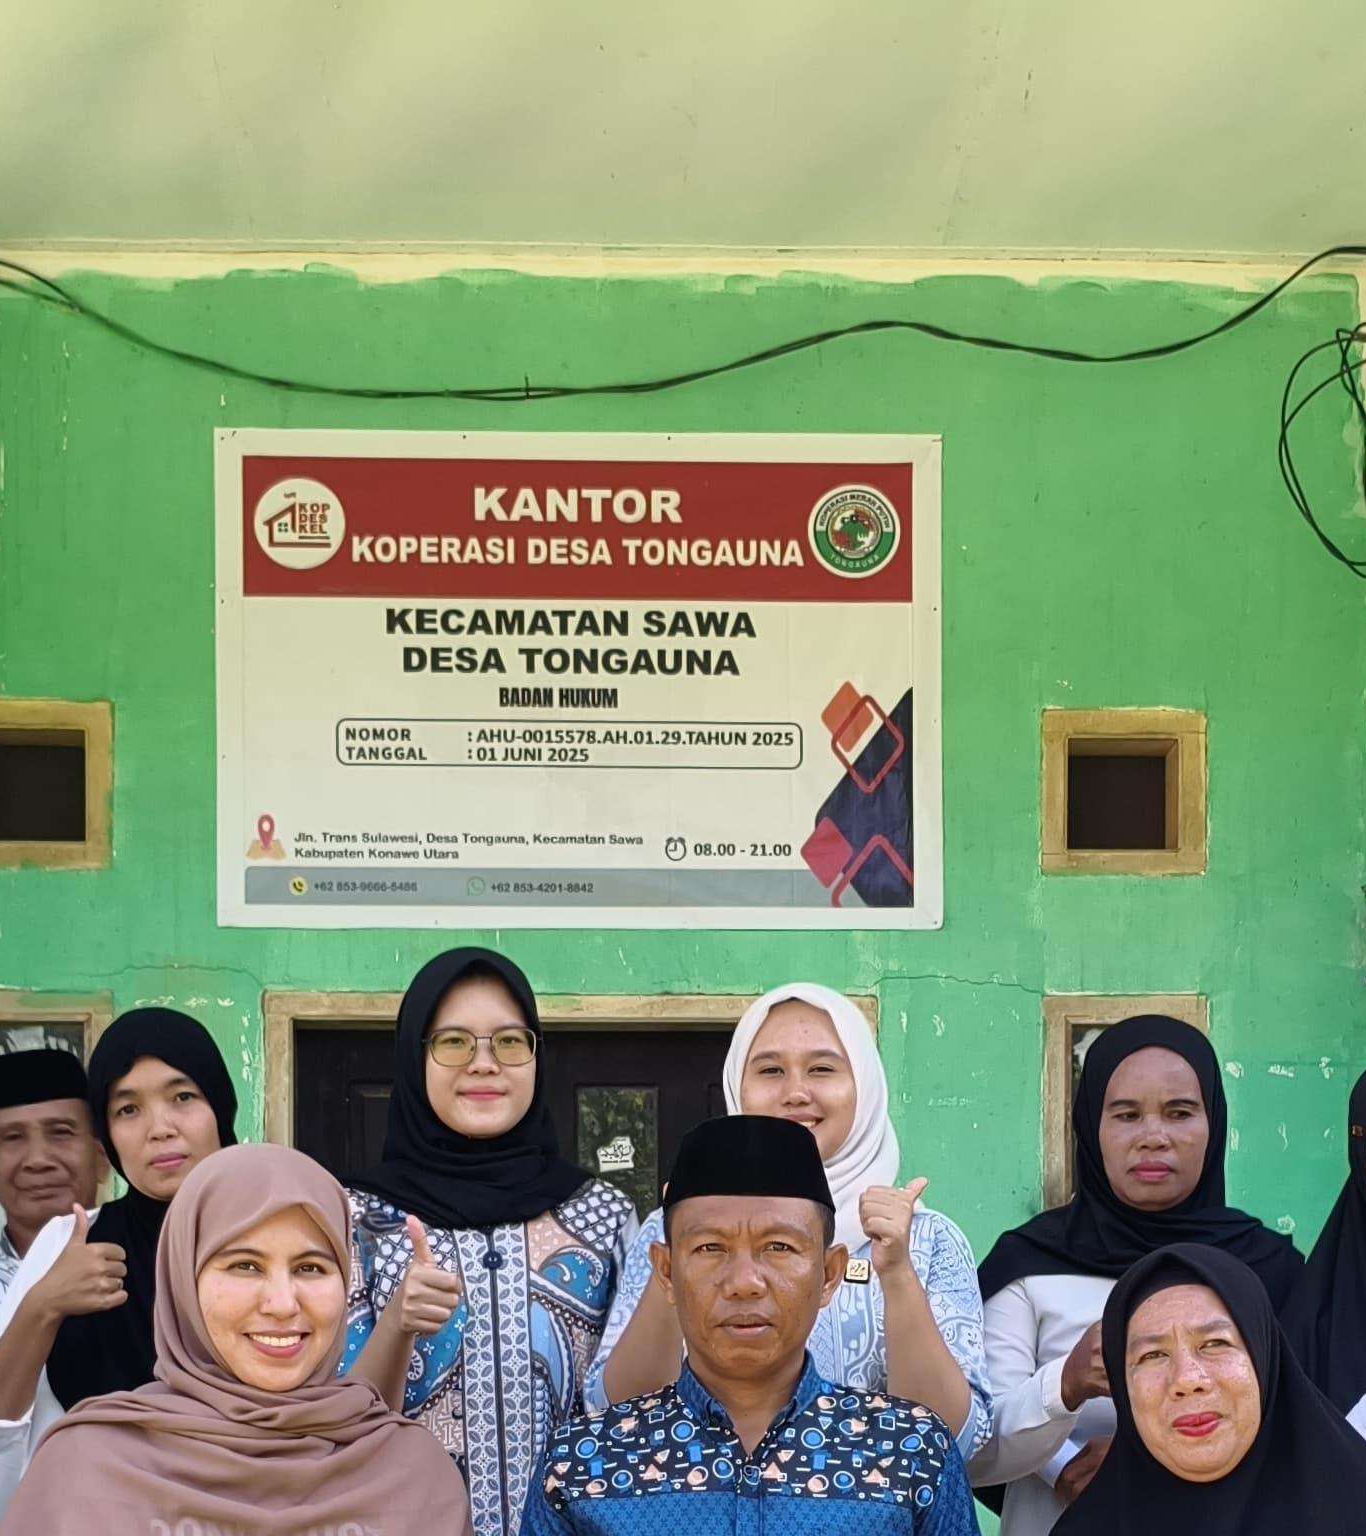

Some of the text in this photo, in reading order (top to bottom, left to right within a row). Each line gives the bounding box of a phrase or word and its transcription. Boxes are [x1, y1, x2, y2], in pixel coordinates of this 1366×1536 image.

[298, 502, 331, 513] KOP
[474, 486, 683, 524] KANTOR
[298, 513, 328, 523] DES
[298, 524, 328, 534] KEL
[351, 535, 805, 568] KOPERASI DESA TONGAUNA
[385, 608, 757, 638] KECAMATAN SAWA
[402, 646, 740, 677] DESA TONGAUNA
[498, 687, 619, 709] BADAN HUKUM
[345, 727, 412, 742] NOMOR
[476, 728, 747, 746] AHU-0015578.AH.01.29.TAHUN
[751, 730, 795, 746] 2025
[345, 746, 428, 762] TANGGAL
[477, 747, 497, 762] 01
[501, 748, 543, 763] JUNI
[547, 748, 590, 763] 2025
[294, 832, 644, 847] Jln. Trans Sulawesi, Desa Tongauna, Kecamatan Sawa
[294, 847, 459, 861] Kabupaten Konawe Utara
[693, 842, 737, 858] 08.00
[750, 842, 793, 858] 21.00
[490, 882, 511, 894] +62
